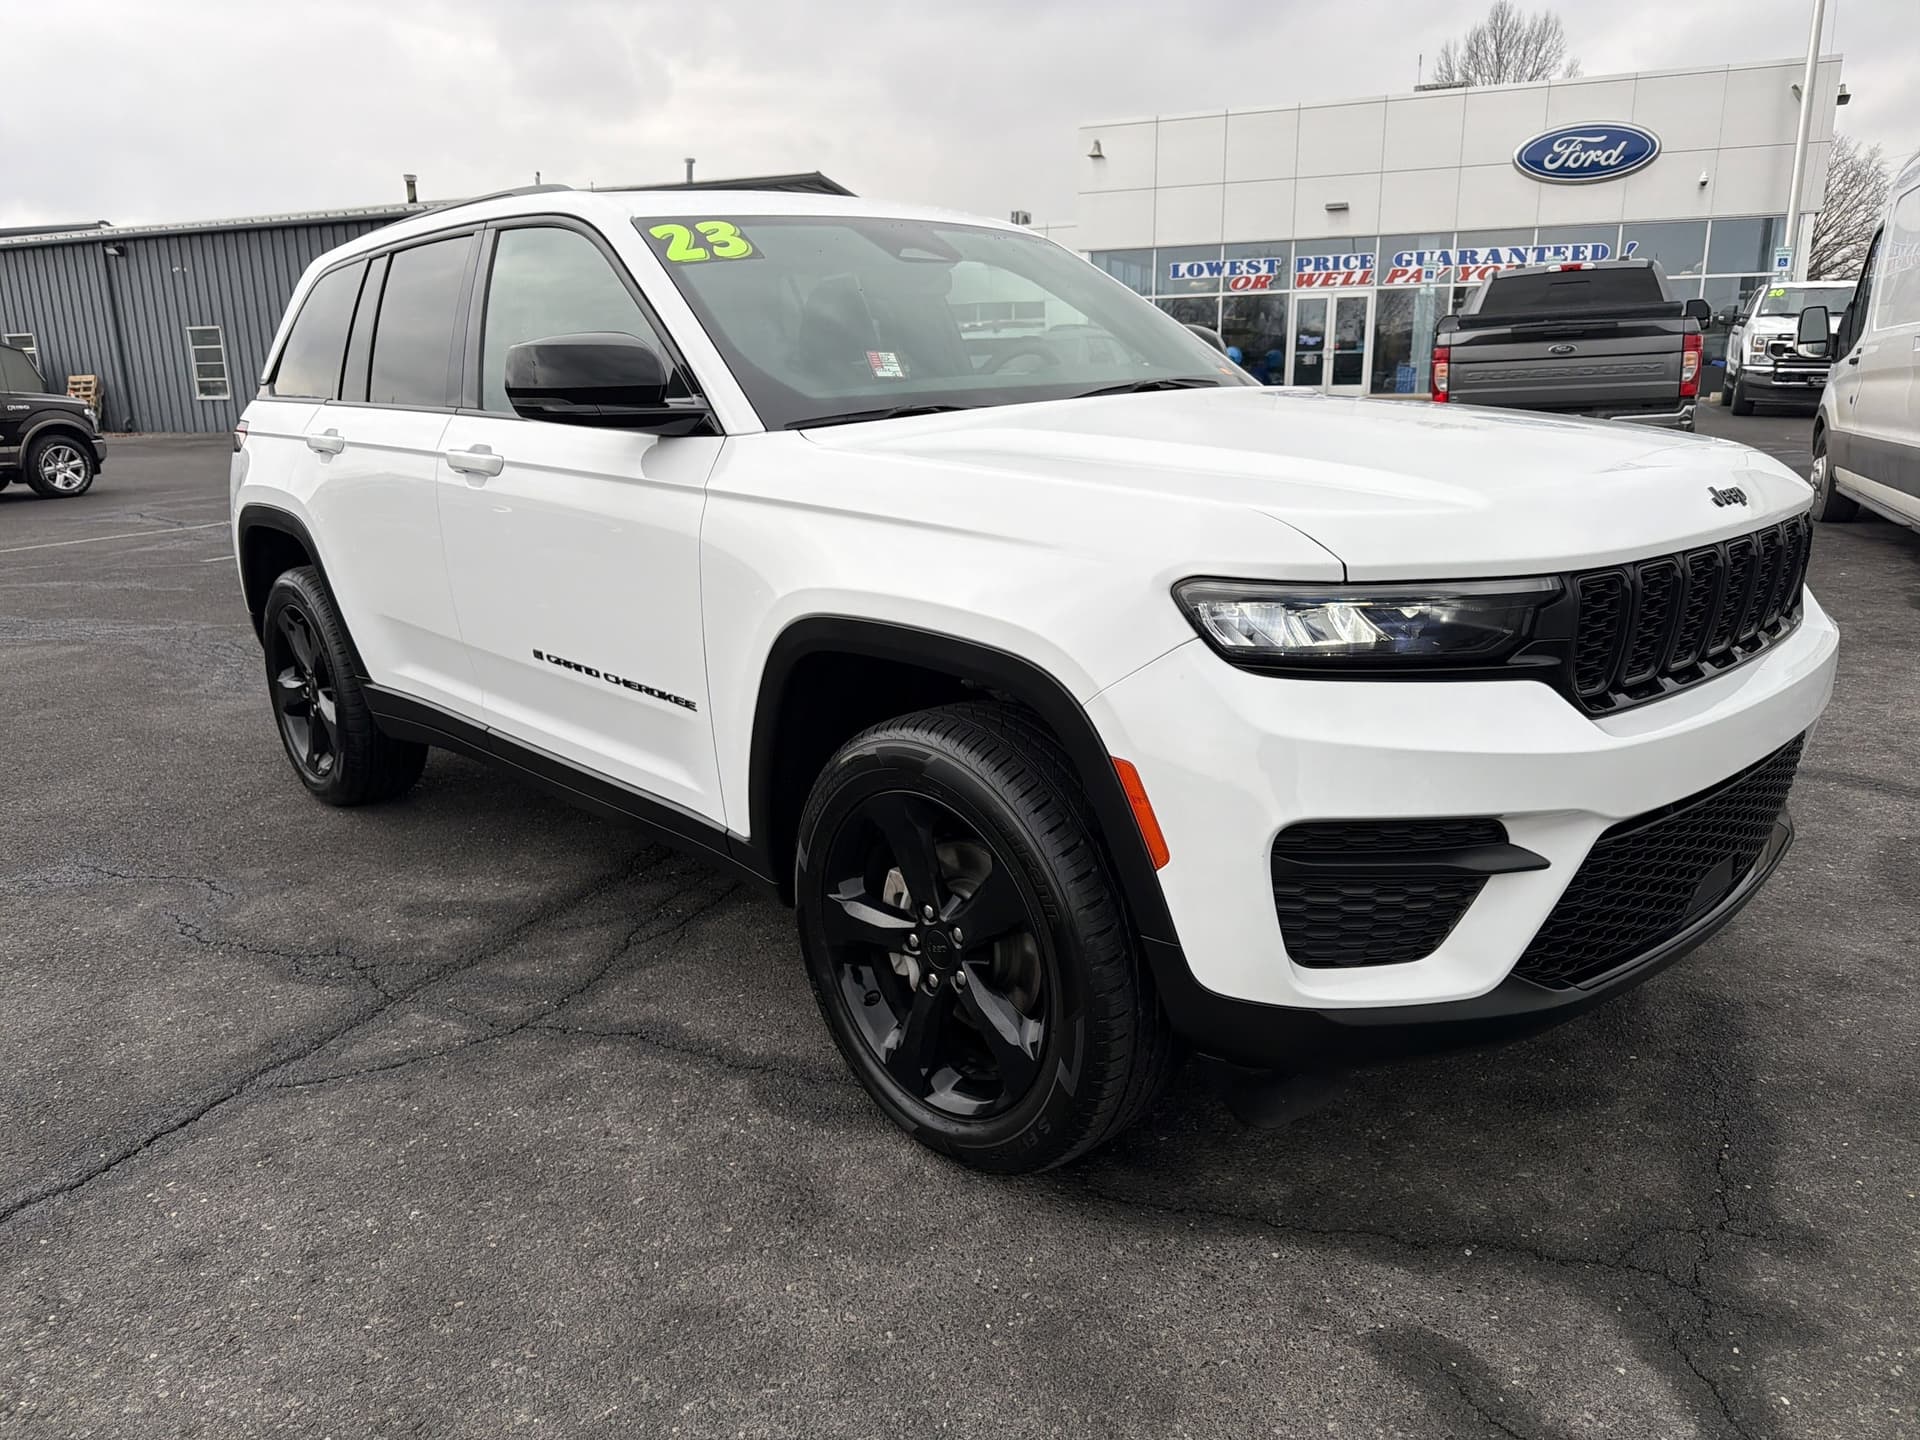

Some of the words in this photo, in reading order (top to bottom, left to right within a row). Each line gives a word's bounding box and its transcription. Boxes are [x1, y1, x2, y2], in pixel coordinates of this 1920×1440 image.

[1543, 134, 1629, 170] Ford
[648, 220, 753, 262] 23
[1170, 258, 1281, 280] LOWEST
[1296, 253, 1375, 272] PRICE
[1393, 243, 1611, 267] GUARANTEED
[1230, 274, 1273, 291] OR
[1707, 486, 1747, 507] Jeep
[546, 654, 601, 679] GRAND
[603, 672, 698, 713] CHEROKEE
